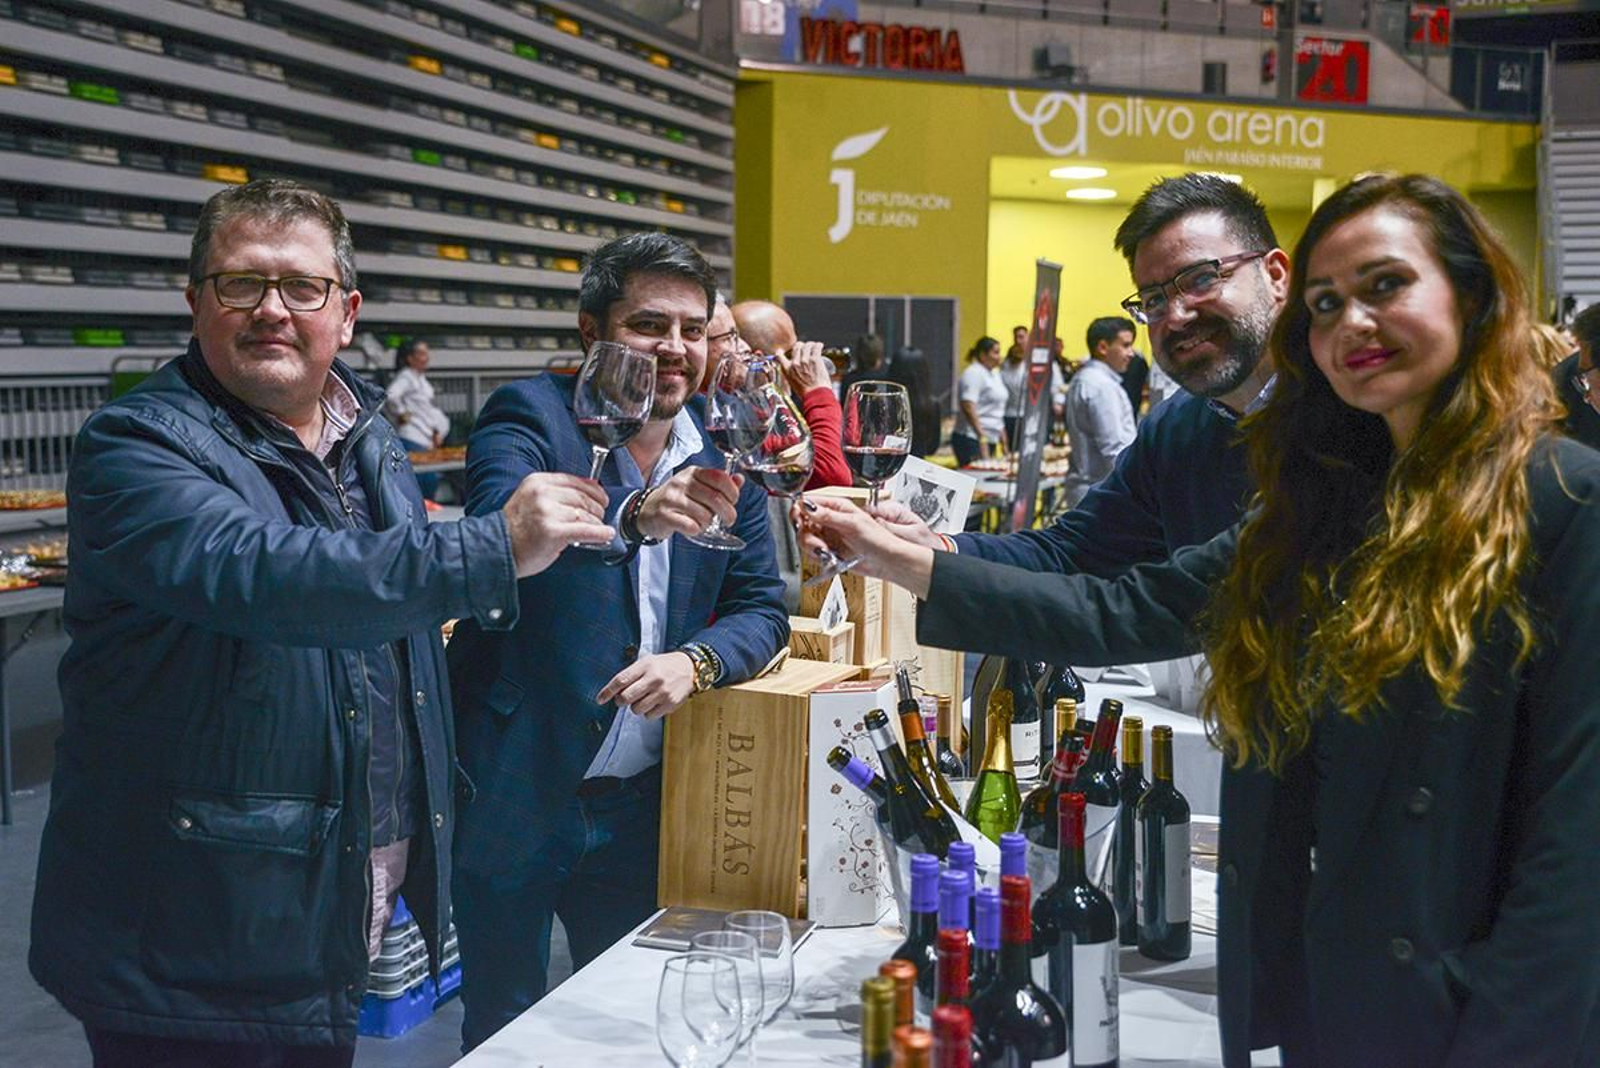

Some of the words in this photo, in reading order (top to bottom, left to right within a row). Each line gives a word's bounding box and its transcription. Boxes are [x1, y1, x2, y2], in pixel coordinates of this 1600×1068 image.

[800, 17, 965, 75] VICTORIA
[1097, 97, 1195, 140] olivo
[1207, 109, 1325, 148] arena
[856, 209, 876, 225] DE
[722, 731, 757, 876] BALBÁS
